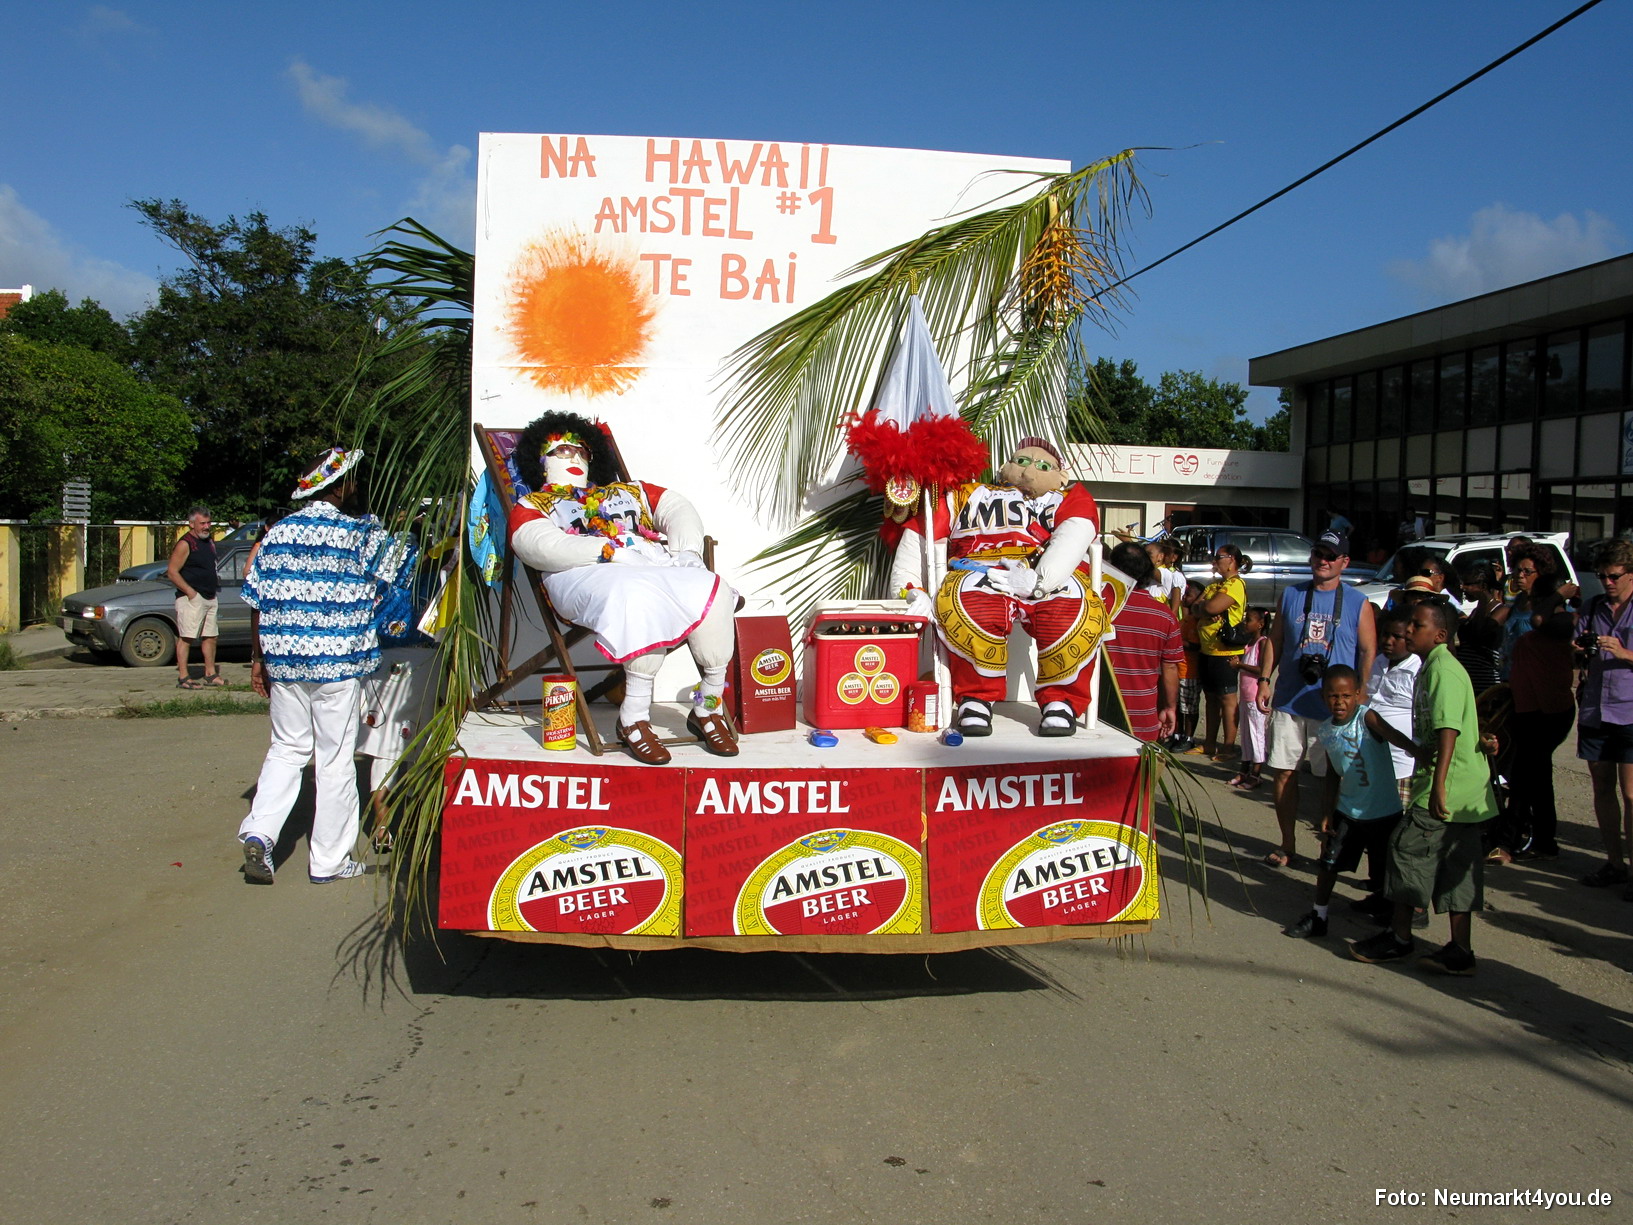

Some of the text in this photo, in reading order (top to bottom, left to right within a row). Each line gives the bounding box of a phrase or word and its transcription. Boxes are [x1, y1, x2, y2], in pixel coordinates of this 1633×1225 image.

[540, 136, 596, 179] NA
[594, 186, 754, 241] AMSTEL
[640, 253, 692, 297] TE
[1204, 472, 1242, 480] decoration
[758, 655, 782, 667] AMSTEL
[764, 662, 779, 671] BEER
[755, 688, 777, 696] AMSTEL
[453, 768, 611, 811] AMSTEL
[695, 778, 850, 815] AMSTEL
[935, 772, 1084, 813] AMSTEL
[621, 835, 658, 852] BEER
[862, 836, 898, 852] BEER
[1065, 843, 1091, 853] PRODUCT
[558, 852, 614, 865] QUALITY PRODUCT
[828, 853, 855, 862] PRODUCT
[527, 857, 651, 896] AMSTEL
[772, 857, 893, 901] AMSTEL
[1013, 845, 1130, 894] AMSTEL
[558, 887, 630, 915] BEER
[802, 888, 872, 918] BEER
[1042, 877, 1110, 909] BEER
[579, 910, 615, 922] LAGER
[823, 911, 858, 924] LAGER
[1063, 900, 1097, 915] LAGER
